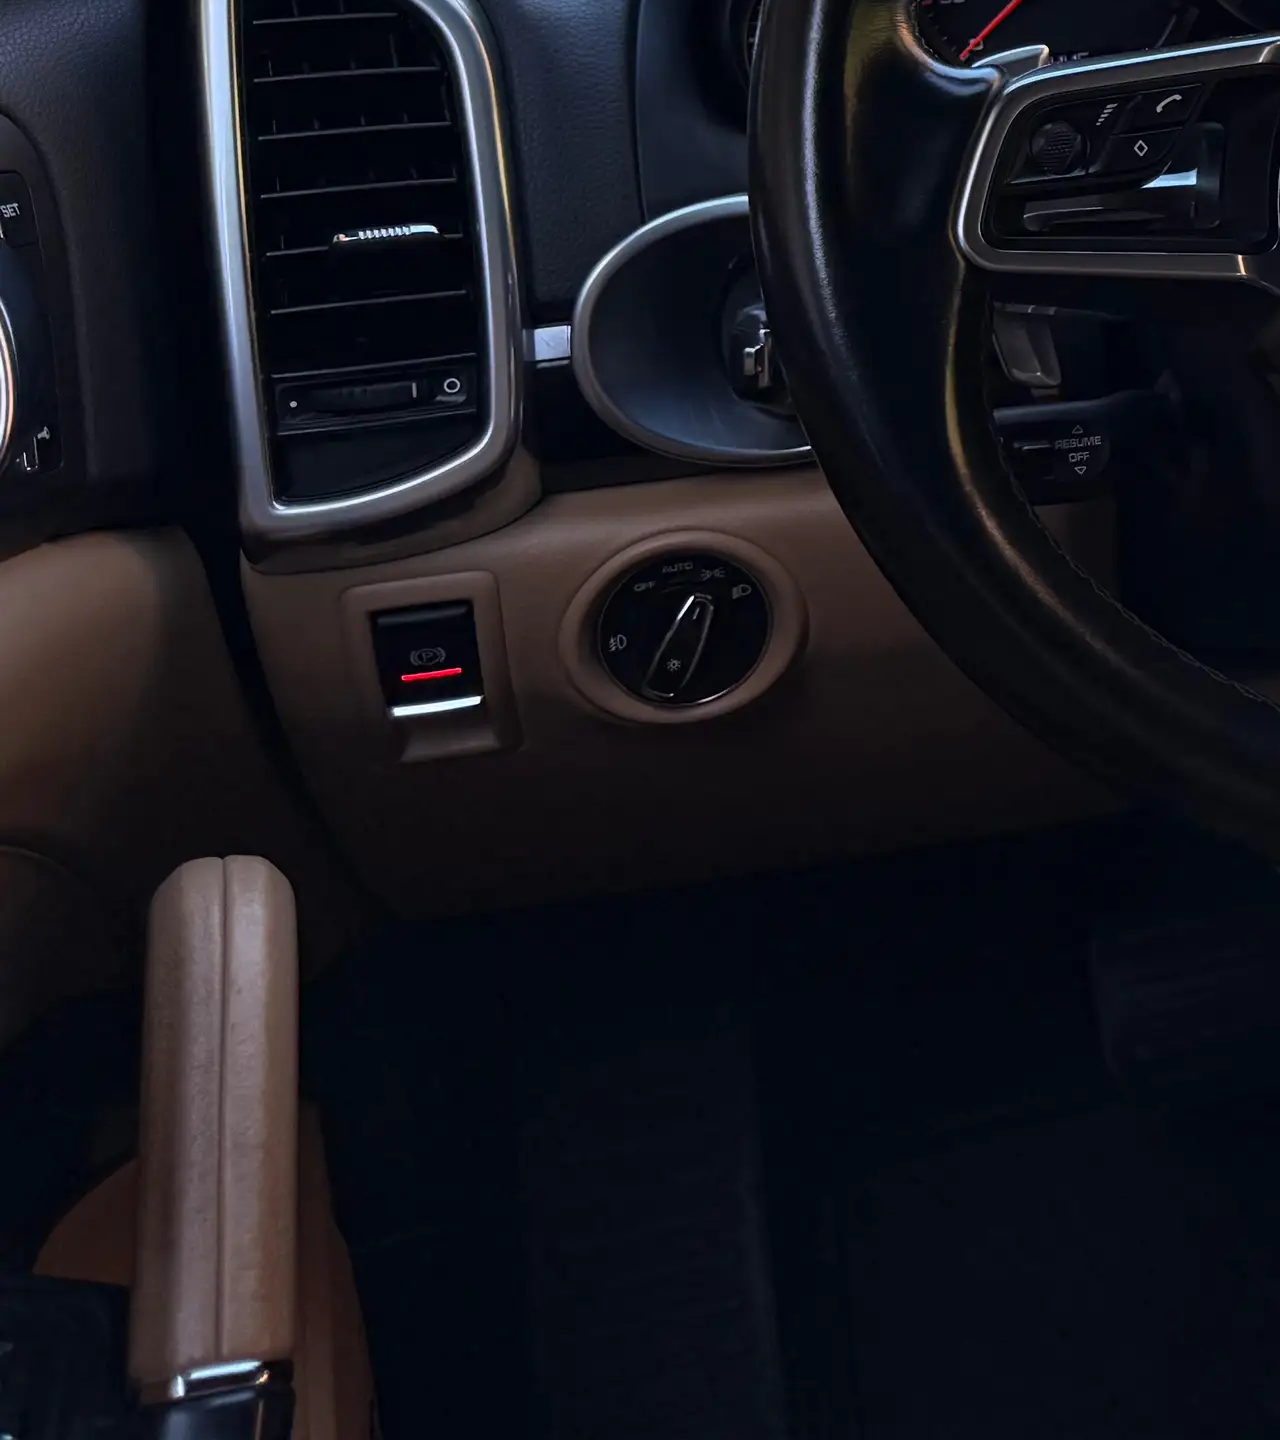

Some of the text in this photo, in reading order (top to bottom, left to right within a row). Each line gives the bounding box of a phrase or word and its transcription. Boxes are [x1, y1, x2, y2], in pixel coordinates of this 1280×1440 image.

[0, 202, 20, 218] SET
[1054, 435, 1102, 450] RESUME
[1068, 451, 1090, 464] OFF
[662, 561, 694, 574] AUTO
[634, 580, 656, 592] OFF
